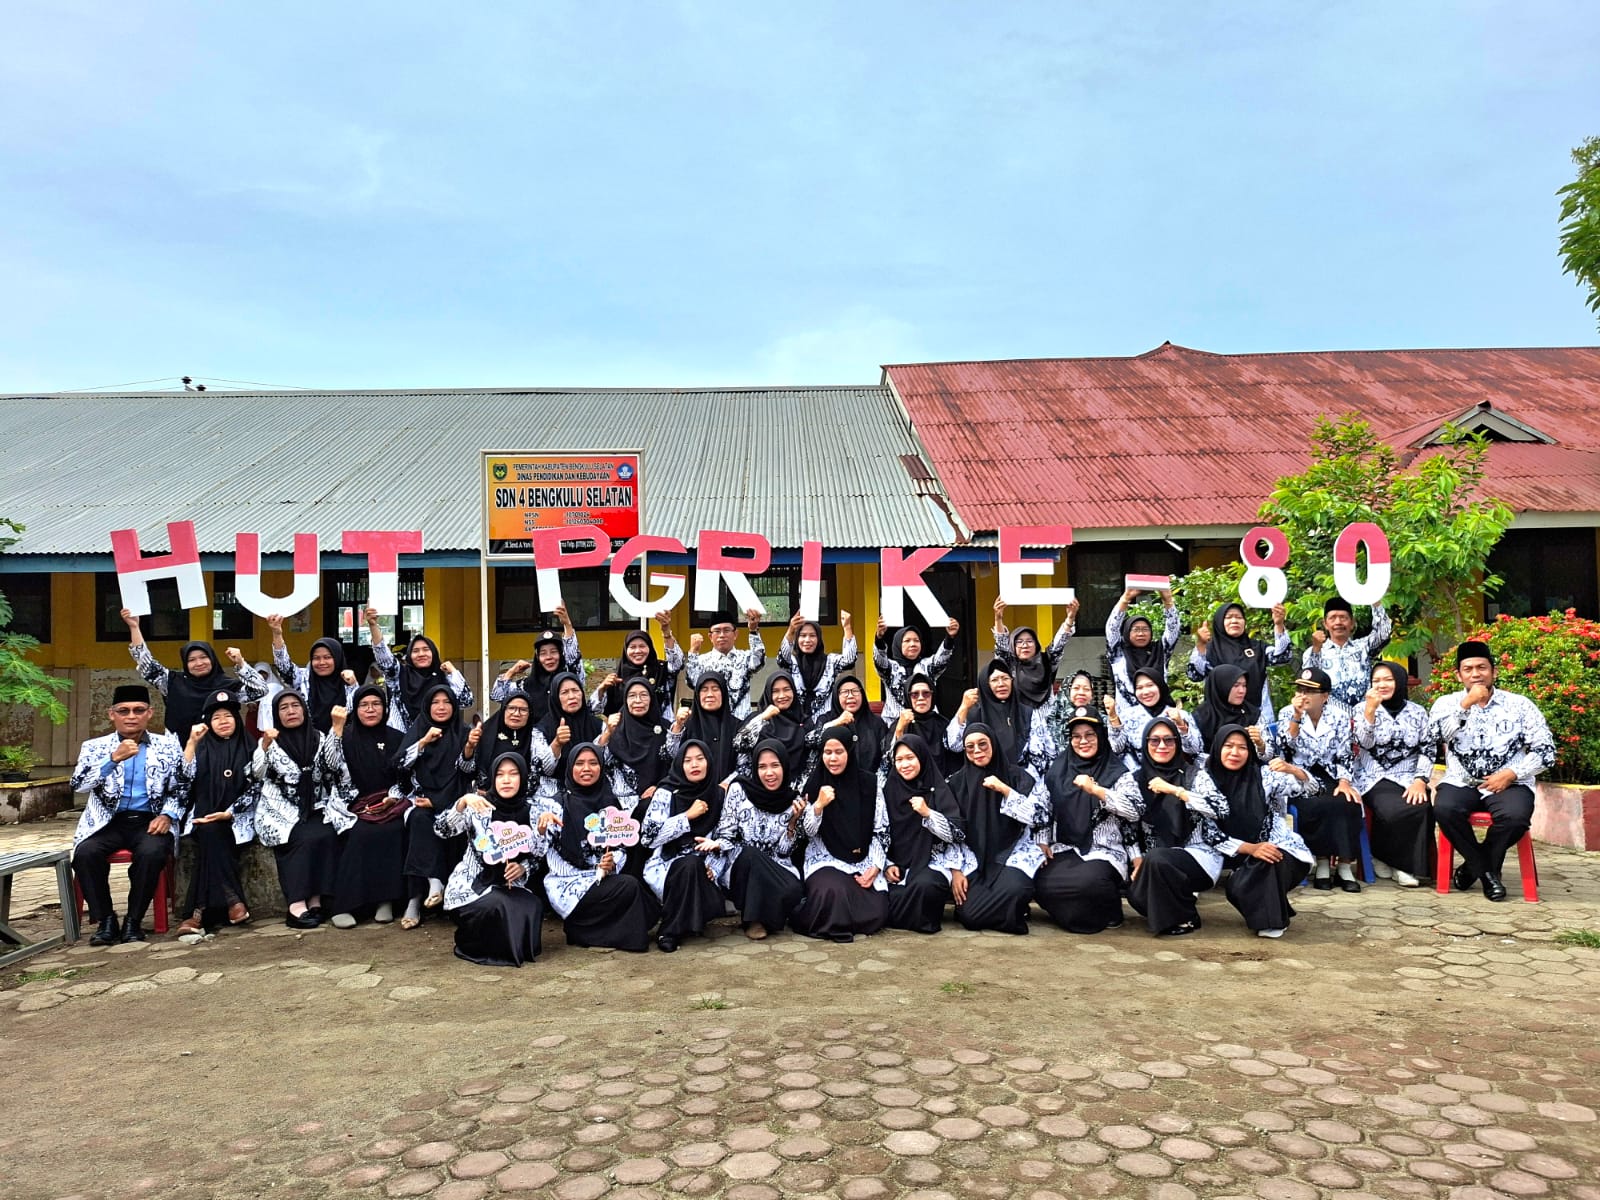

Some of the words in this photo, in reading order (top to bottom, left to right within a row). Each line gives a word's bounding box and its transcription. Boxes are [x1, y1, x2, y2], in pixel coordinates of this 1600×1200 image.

[593, 462, 614, 470] SELATAN
[517, 472, 532, 480] DINAS
[533, 472, 563, 480] PENDIDIKAN
[565, 472, 575, 480] DAN
[576, 472, 610, 480] KEBUDAYAAN
[496, 488, 516, 507] SDN
[519, 488, 525, 507] 4
[528, 488, 583, 507] BENGKULU
[586, 487, 631, 507] SELATAN
[110, 520, 424, 617] HUT
[532, 525, 822, 621] PGRI
[880, 526, 1075, 627] KE
[1239, 522, 1391, 608] 80
[613, 816, 623, 824] My
[605, 832, 633, 840] Teacher
[500, 839, 528, 853] Teacher
